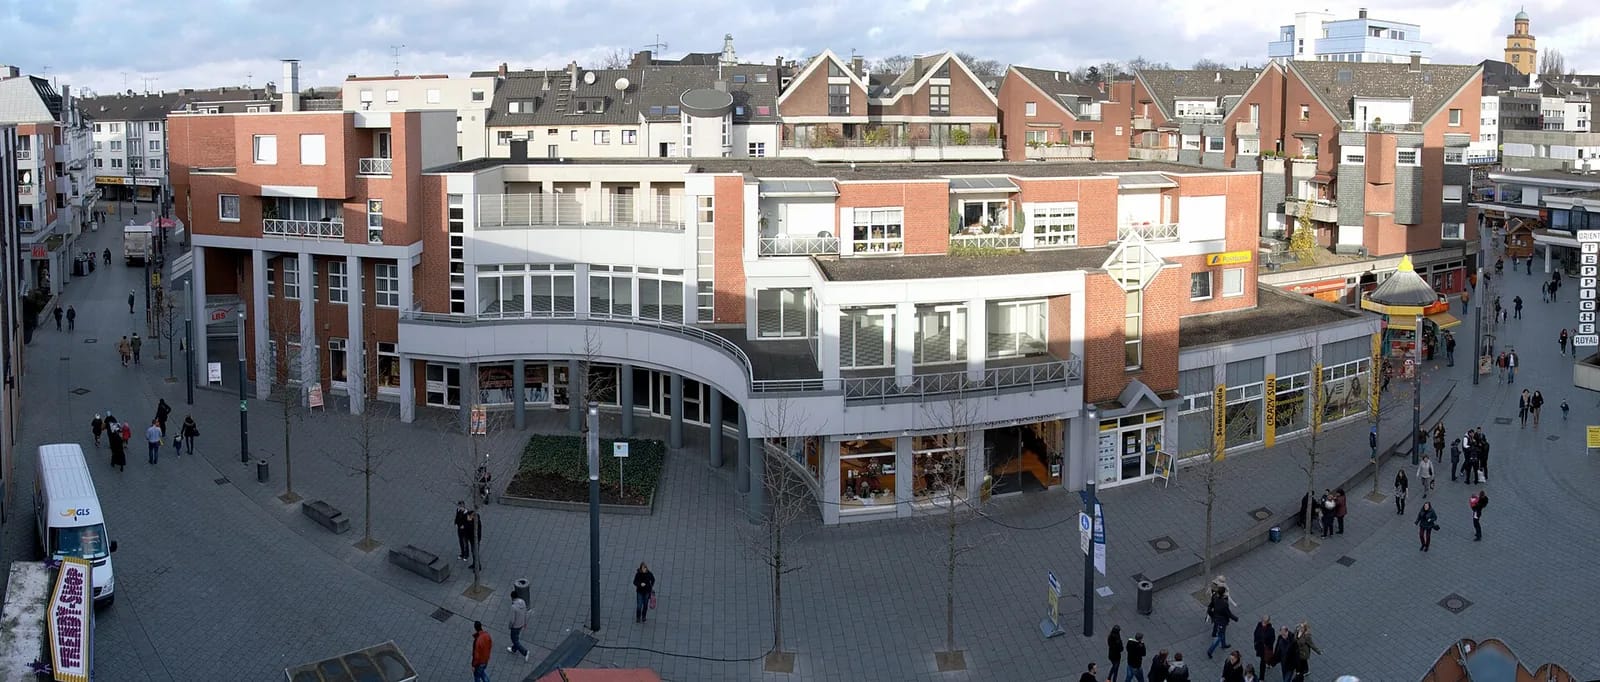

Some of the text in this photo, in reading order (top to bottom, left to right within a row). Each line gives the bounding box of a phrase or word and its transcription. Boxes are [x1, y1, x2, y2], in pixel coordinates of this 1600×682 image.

[1578, 232, 1600, 240] ORIENT
[1581, 244, 1595, 332] TEPPICHE
[1575, 336, 1598, 345] ROYAL
[1266, 378, 1275, 426] CRAZY SUN
[76, 508, 91, 516] GLS
